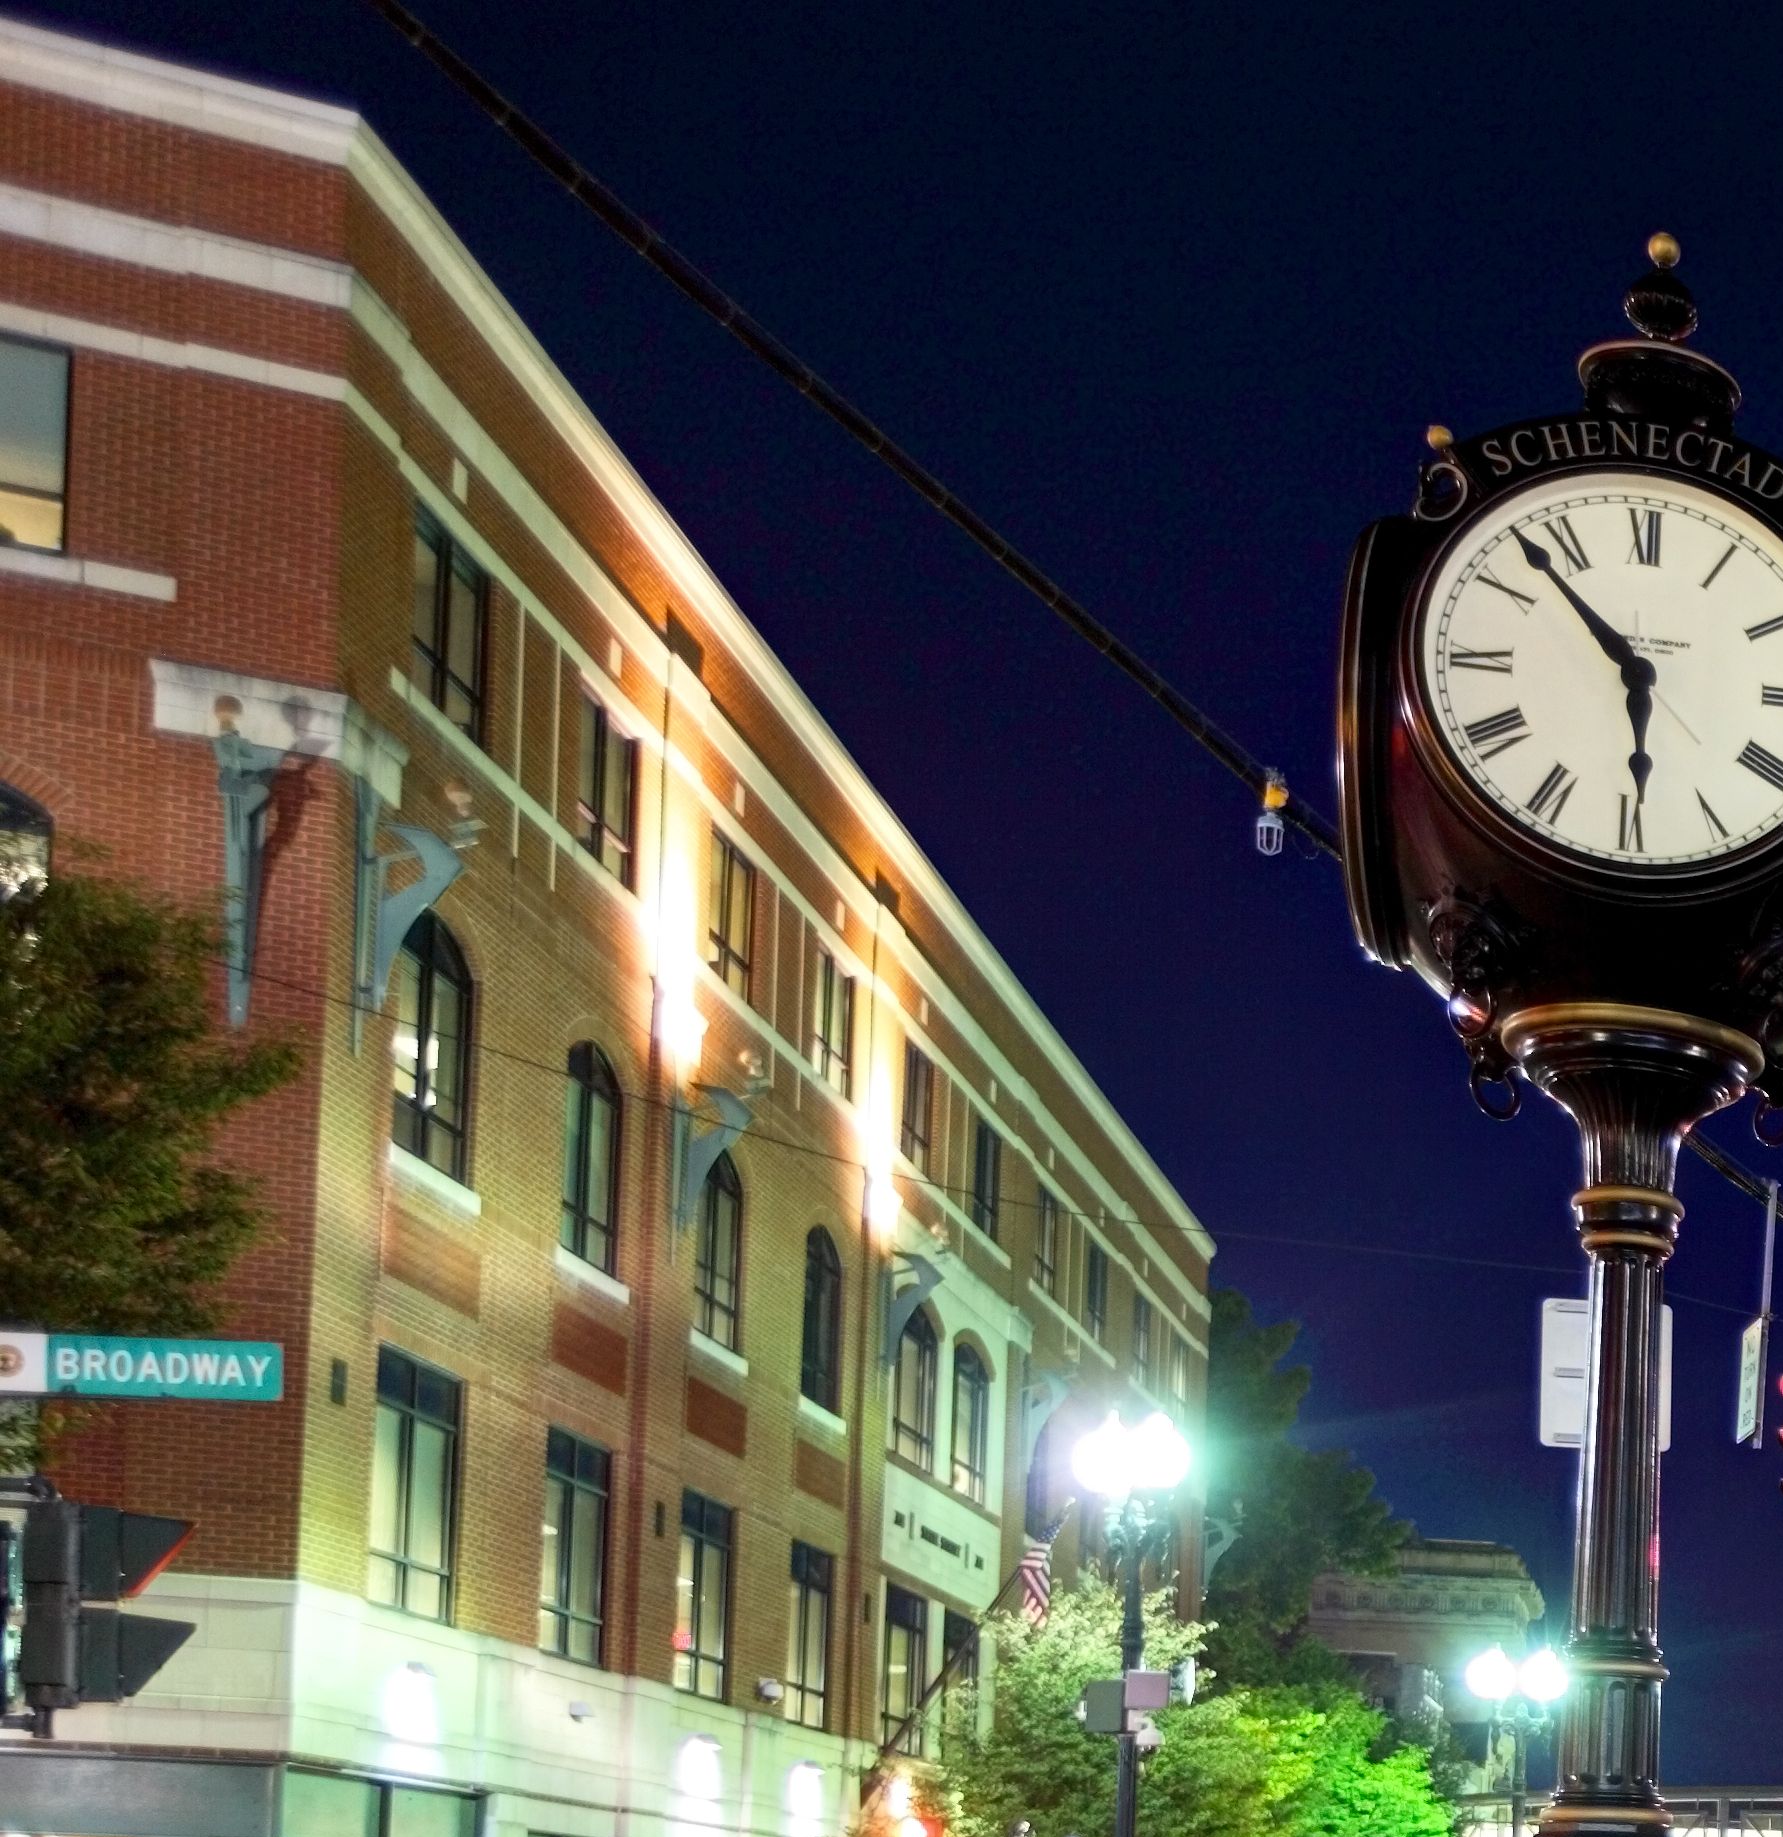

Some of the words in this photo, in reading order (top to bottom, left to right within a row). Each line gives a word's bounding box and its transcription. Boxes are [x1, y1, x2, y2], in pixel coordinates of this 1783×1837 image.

[1626, 508, 1663, 568] XII
[1650, 638, 1691, 649] COMPANY
[56, 1348, 272, 1387] BROADWAY
